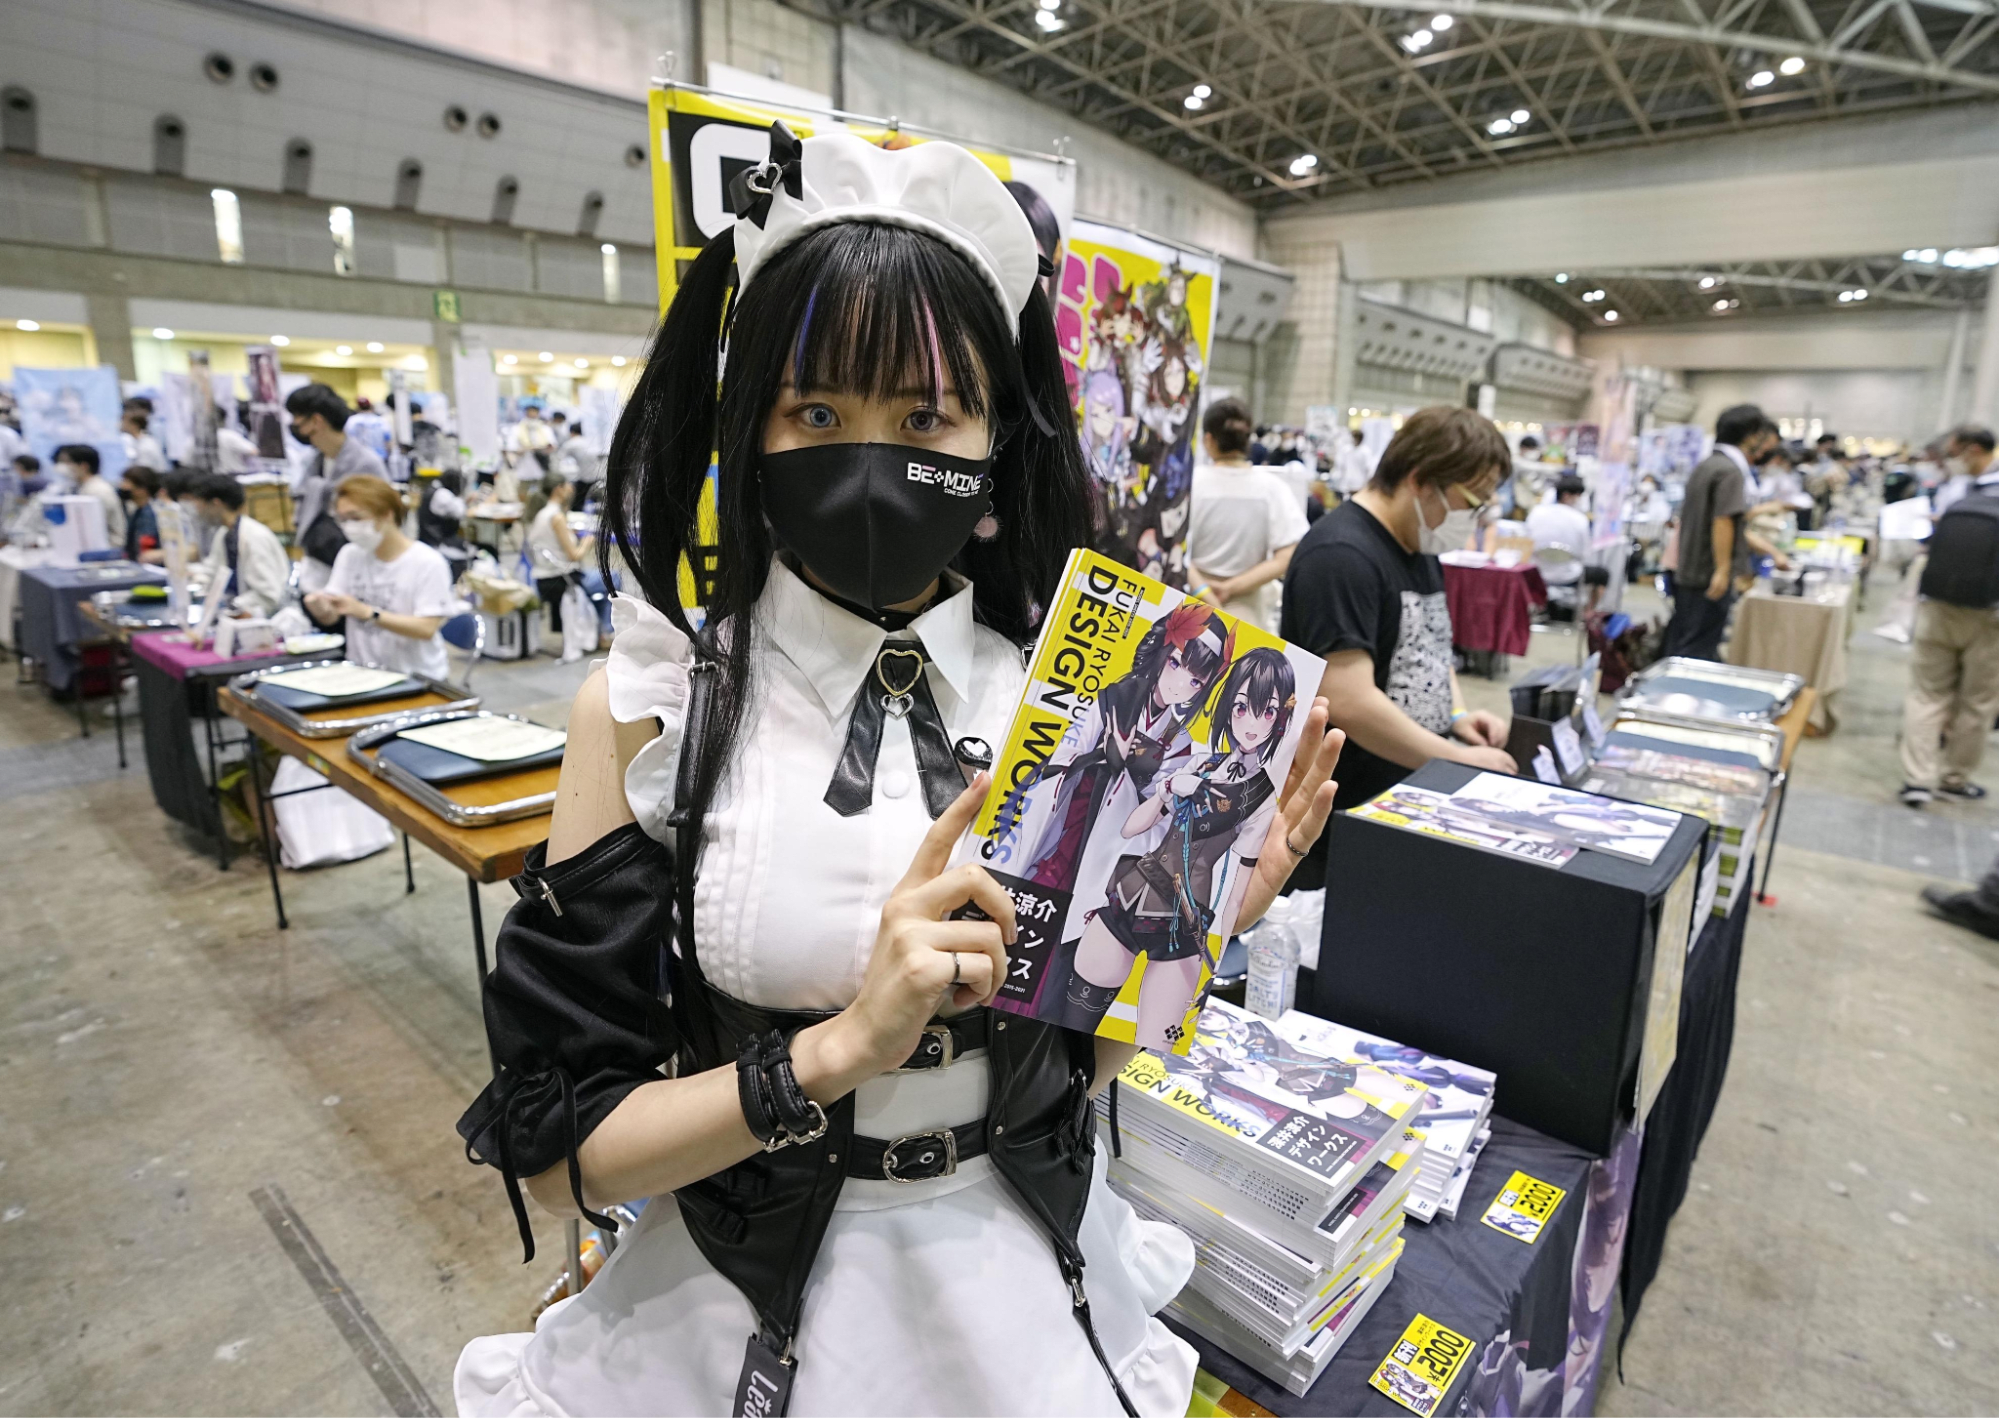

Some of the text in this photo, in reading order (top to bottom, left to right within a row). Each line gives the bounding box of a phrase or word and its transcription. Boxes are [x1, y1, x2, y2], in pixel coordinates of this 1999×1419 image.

[1101, 579, 1138, 643] FUKAI
[981, 565, 1119, 864] DESIGN WORKS
[1061, 647, 1112, 748] RYOSUKE
[1119, 1065, 1261, 1138] SIGN WORKS
[1288, 1125, 1325, 1157] デザイン
[1307, 1134, 1348, 1166] ワークス
